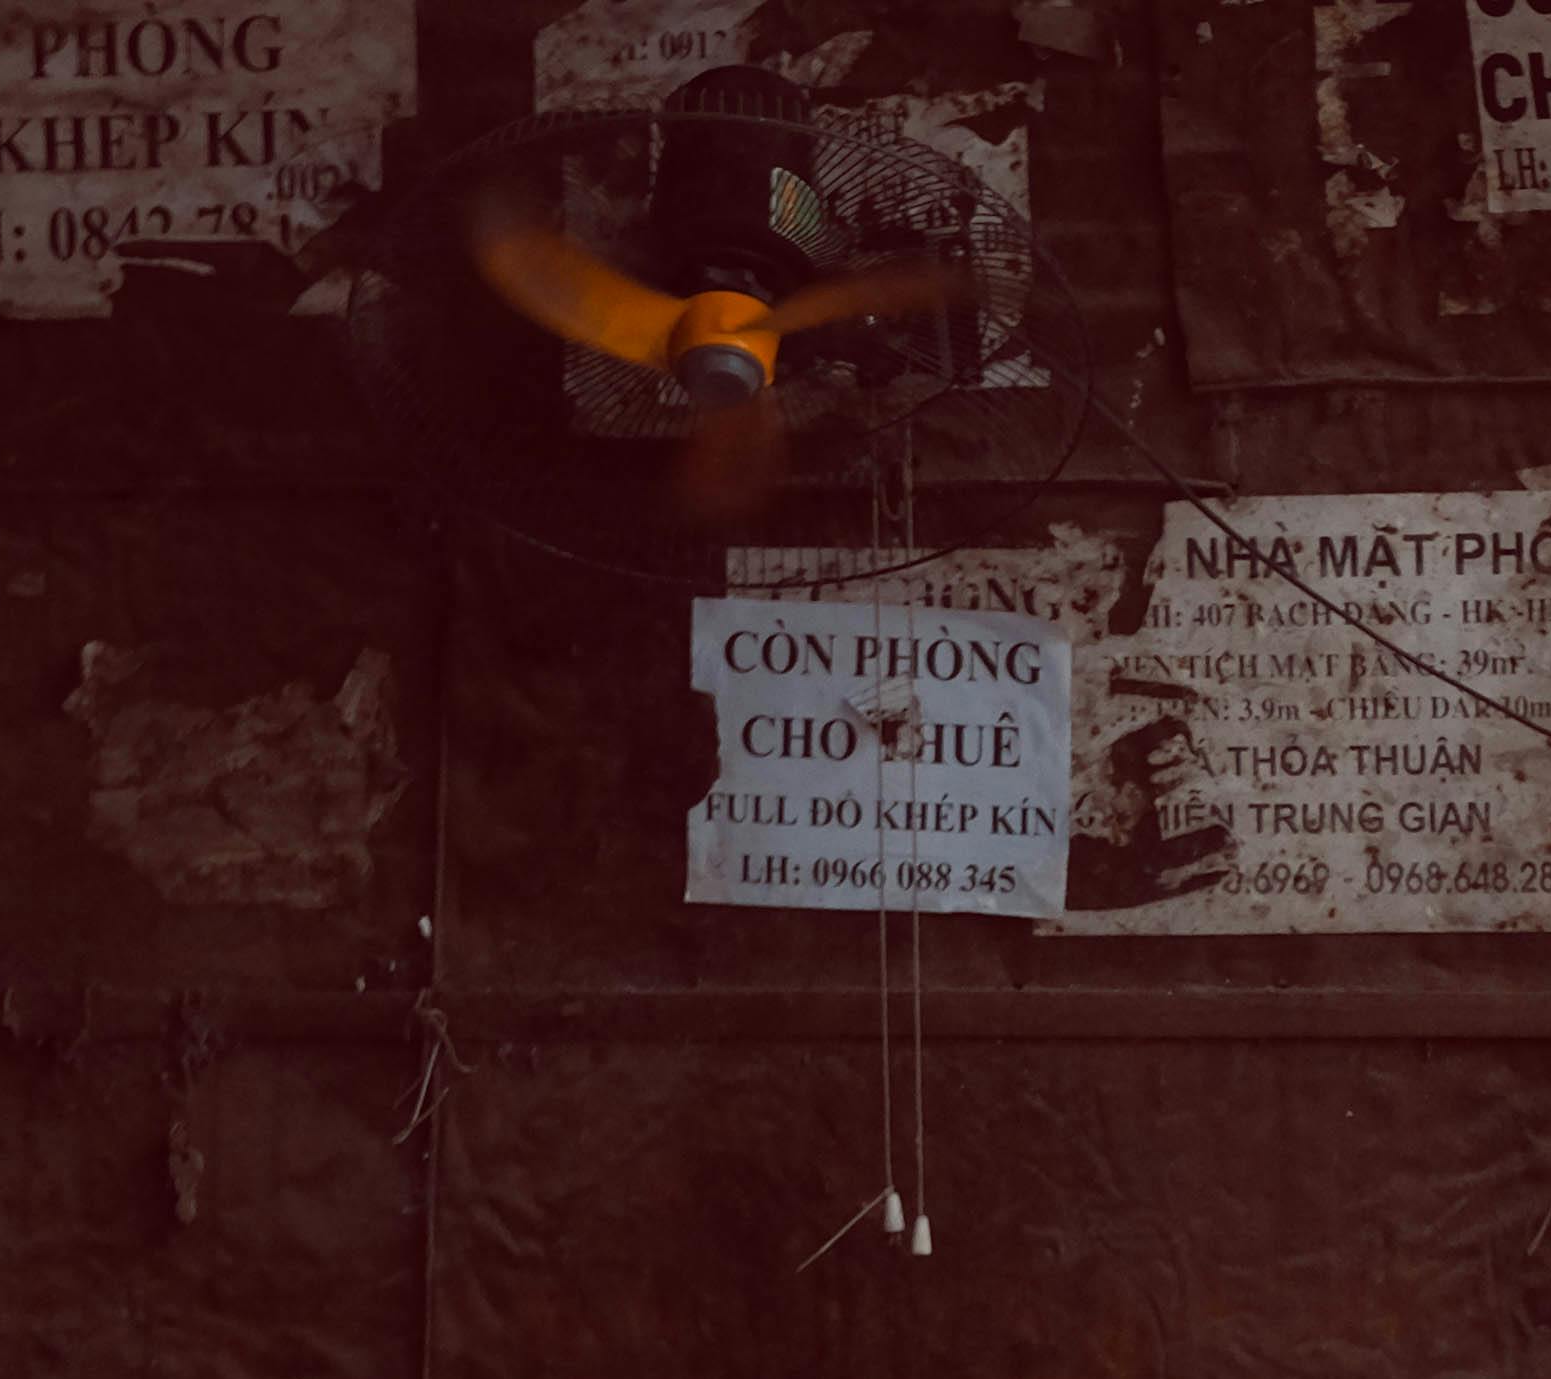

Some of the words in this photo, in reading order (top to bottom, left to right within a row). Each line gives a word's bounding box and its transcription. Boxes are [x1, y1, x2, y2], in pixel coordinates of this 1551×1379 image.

[31, 2, 284, 79] PHÒNG
[1494, 146, 1549, 191] LH:
[1186, 522, 1296, 579] NHÀ
[1191, 603, 1237, 627] 407
[723, 618, 838, 676] CÒN
[852, 625, 1043, 685] PHÒNG
[742, 714, 858, 761] CHO
[1350, 738, 1483, 783] THUẬN
[705, 792, 798, 827] FULL
[875, 793, 979, 834] KHÉP
[991, 797, 1057, 837] KÍN
[1249, 800, 1385, 835] TRUNG
[1398, 799, 1492, 835] GIAN
[740, 854, 801, 887] LH:
[812, 856, 887, 889] 0966
[897, 859, 952, 892] 088
[961, 863, 1017, 894] 345
